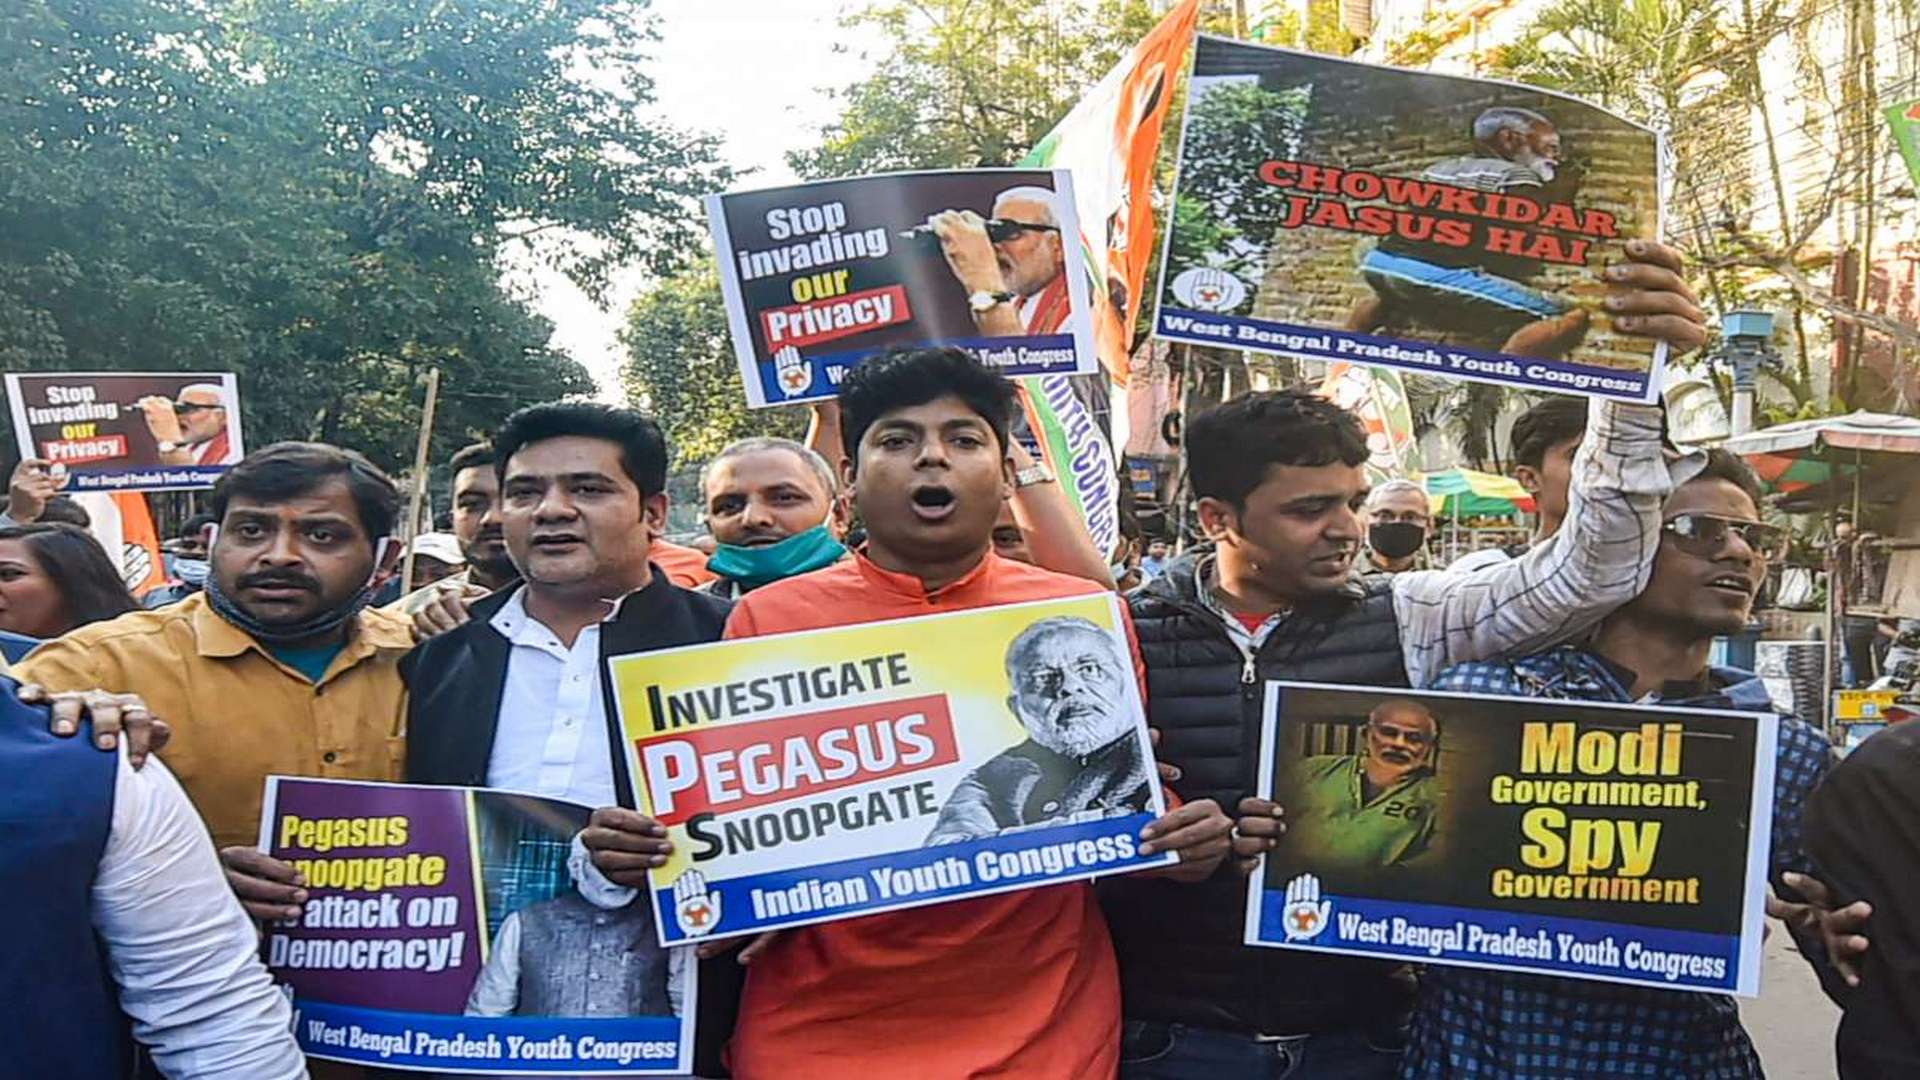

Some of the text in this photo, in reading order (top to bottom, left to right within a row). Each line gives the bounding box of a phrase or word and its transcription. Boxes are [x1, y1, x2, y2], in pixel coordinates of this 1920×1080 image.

[767, 201, 845, 240] Stop
[1258, 160, 1618, 237] CHOWKIDAR
[738, 227, 889, 280] invading
[1281, 197, 1588, 266] JASUS HAI
[791, 268, 851, 303] our
[768, 295, 893, 342] Privacy
[980, 348, 1017, 366] Youth
[1018, 347, 1074, 368] Congress
[1163, 313, 1642, 394] West Bengal Pradesh Youth Congress
[46, 386, 95, 404] Stop
[47, 439, 118, 460] Privacy
[62, 423, 96, 440] our
[647, 653, 911, 731] INVESTIGATE
[642, 712, 935, 816] PEGASUS
[1520, 721, 1684, 776] Modi
[1491, 775, 1706, 811] Government,
[280, 816, 408, 851] Pegasus
[687, 781, 939, 863] SNOOPGATE
[1520, 808, 1662, 878] Spy
[286, 853, 446, 891] noopgate
[751, 830, 1137, 921] Indian Youth Congress
[1492, 869, 1699, 904] Government
[304, 893, 458, 929] attack on
[269, 931, 465, 971] Democracy!
[1337, 913, 1728, 980] West Bengal Pradesh Youth Congress
[308, 1019, 677, 1066] West Bengal Pradesh Youth Congress
